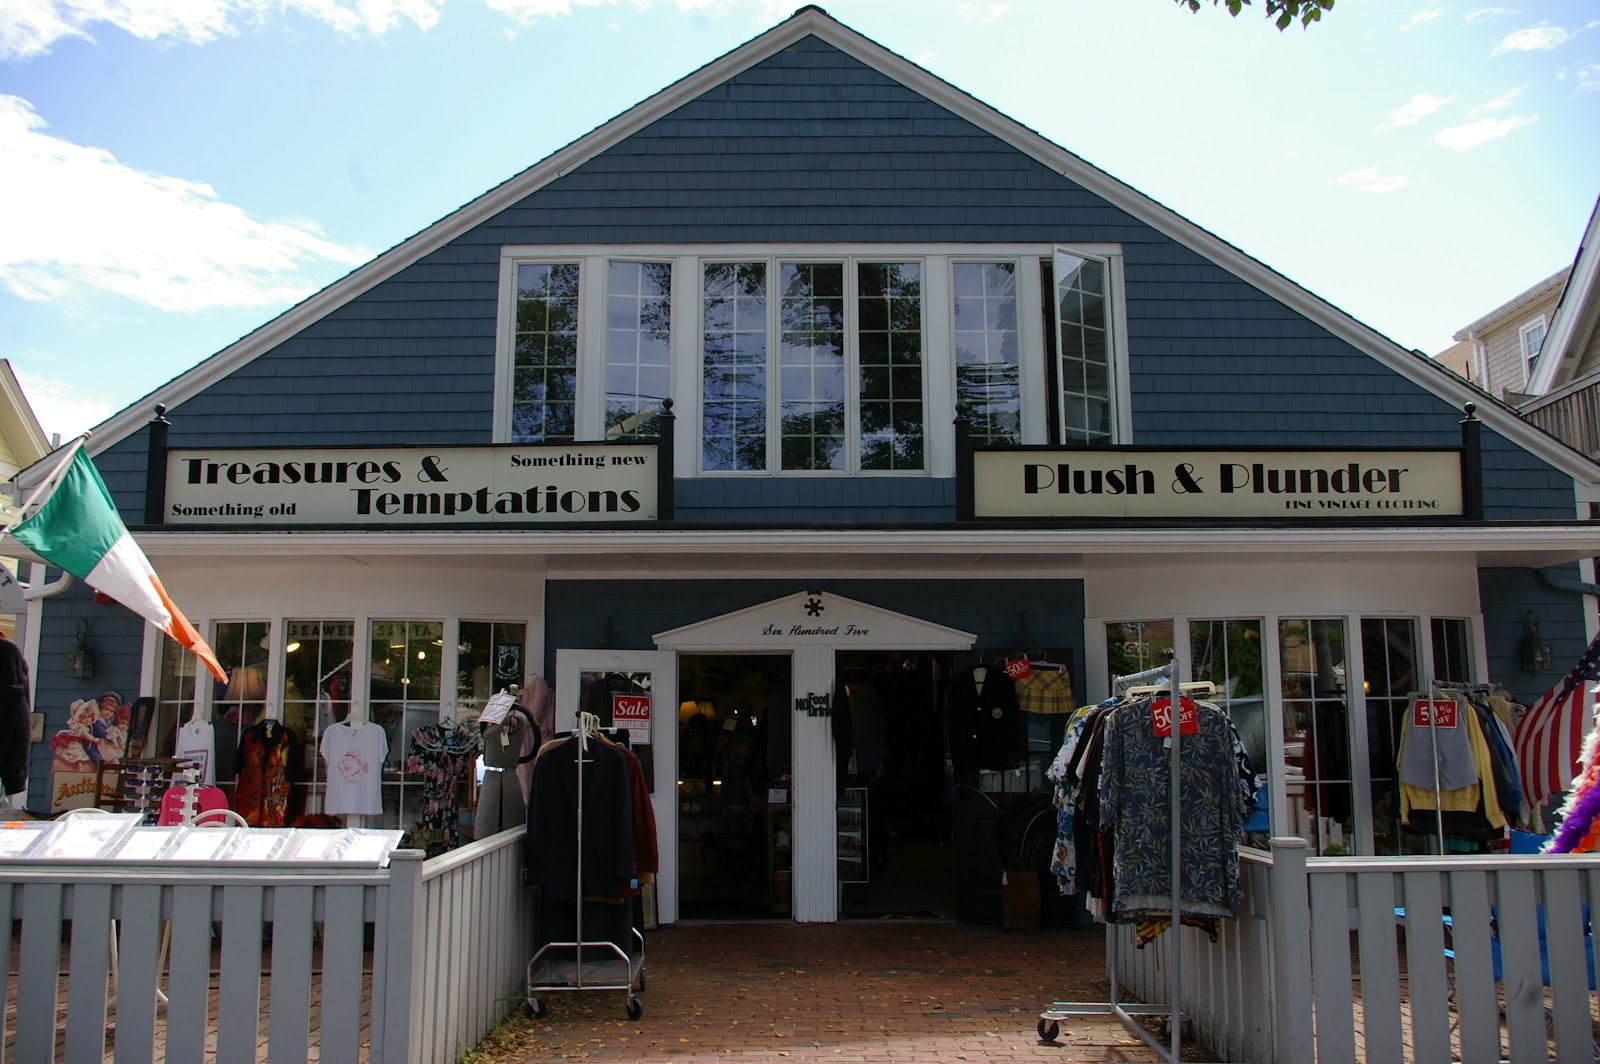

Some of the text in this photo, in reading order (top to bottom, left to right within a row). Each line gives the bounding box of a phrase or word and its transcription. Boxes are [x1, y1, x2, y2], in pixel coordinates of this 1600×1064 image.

[511, 453, 648, 469] Something new
[181, 455, 449, 484] Treasures &
[1024, 462, 1409, 495] Plush & Plunder
[350, 485, 641, 516] Temptations
[1285, 500, 1440, 509] FINE VINTAGE CLOTHING
[172, 502, 297, 518] Something old
[788, 624, 840, 636] Hundred
[844, 624, 870, 636] Five
[808, 692, 830, 705] Food
[615, 701, 649, 716] Sale
